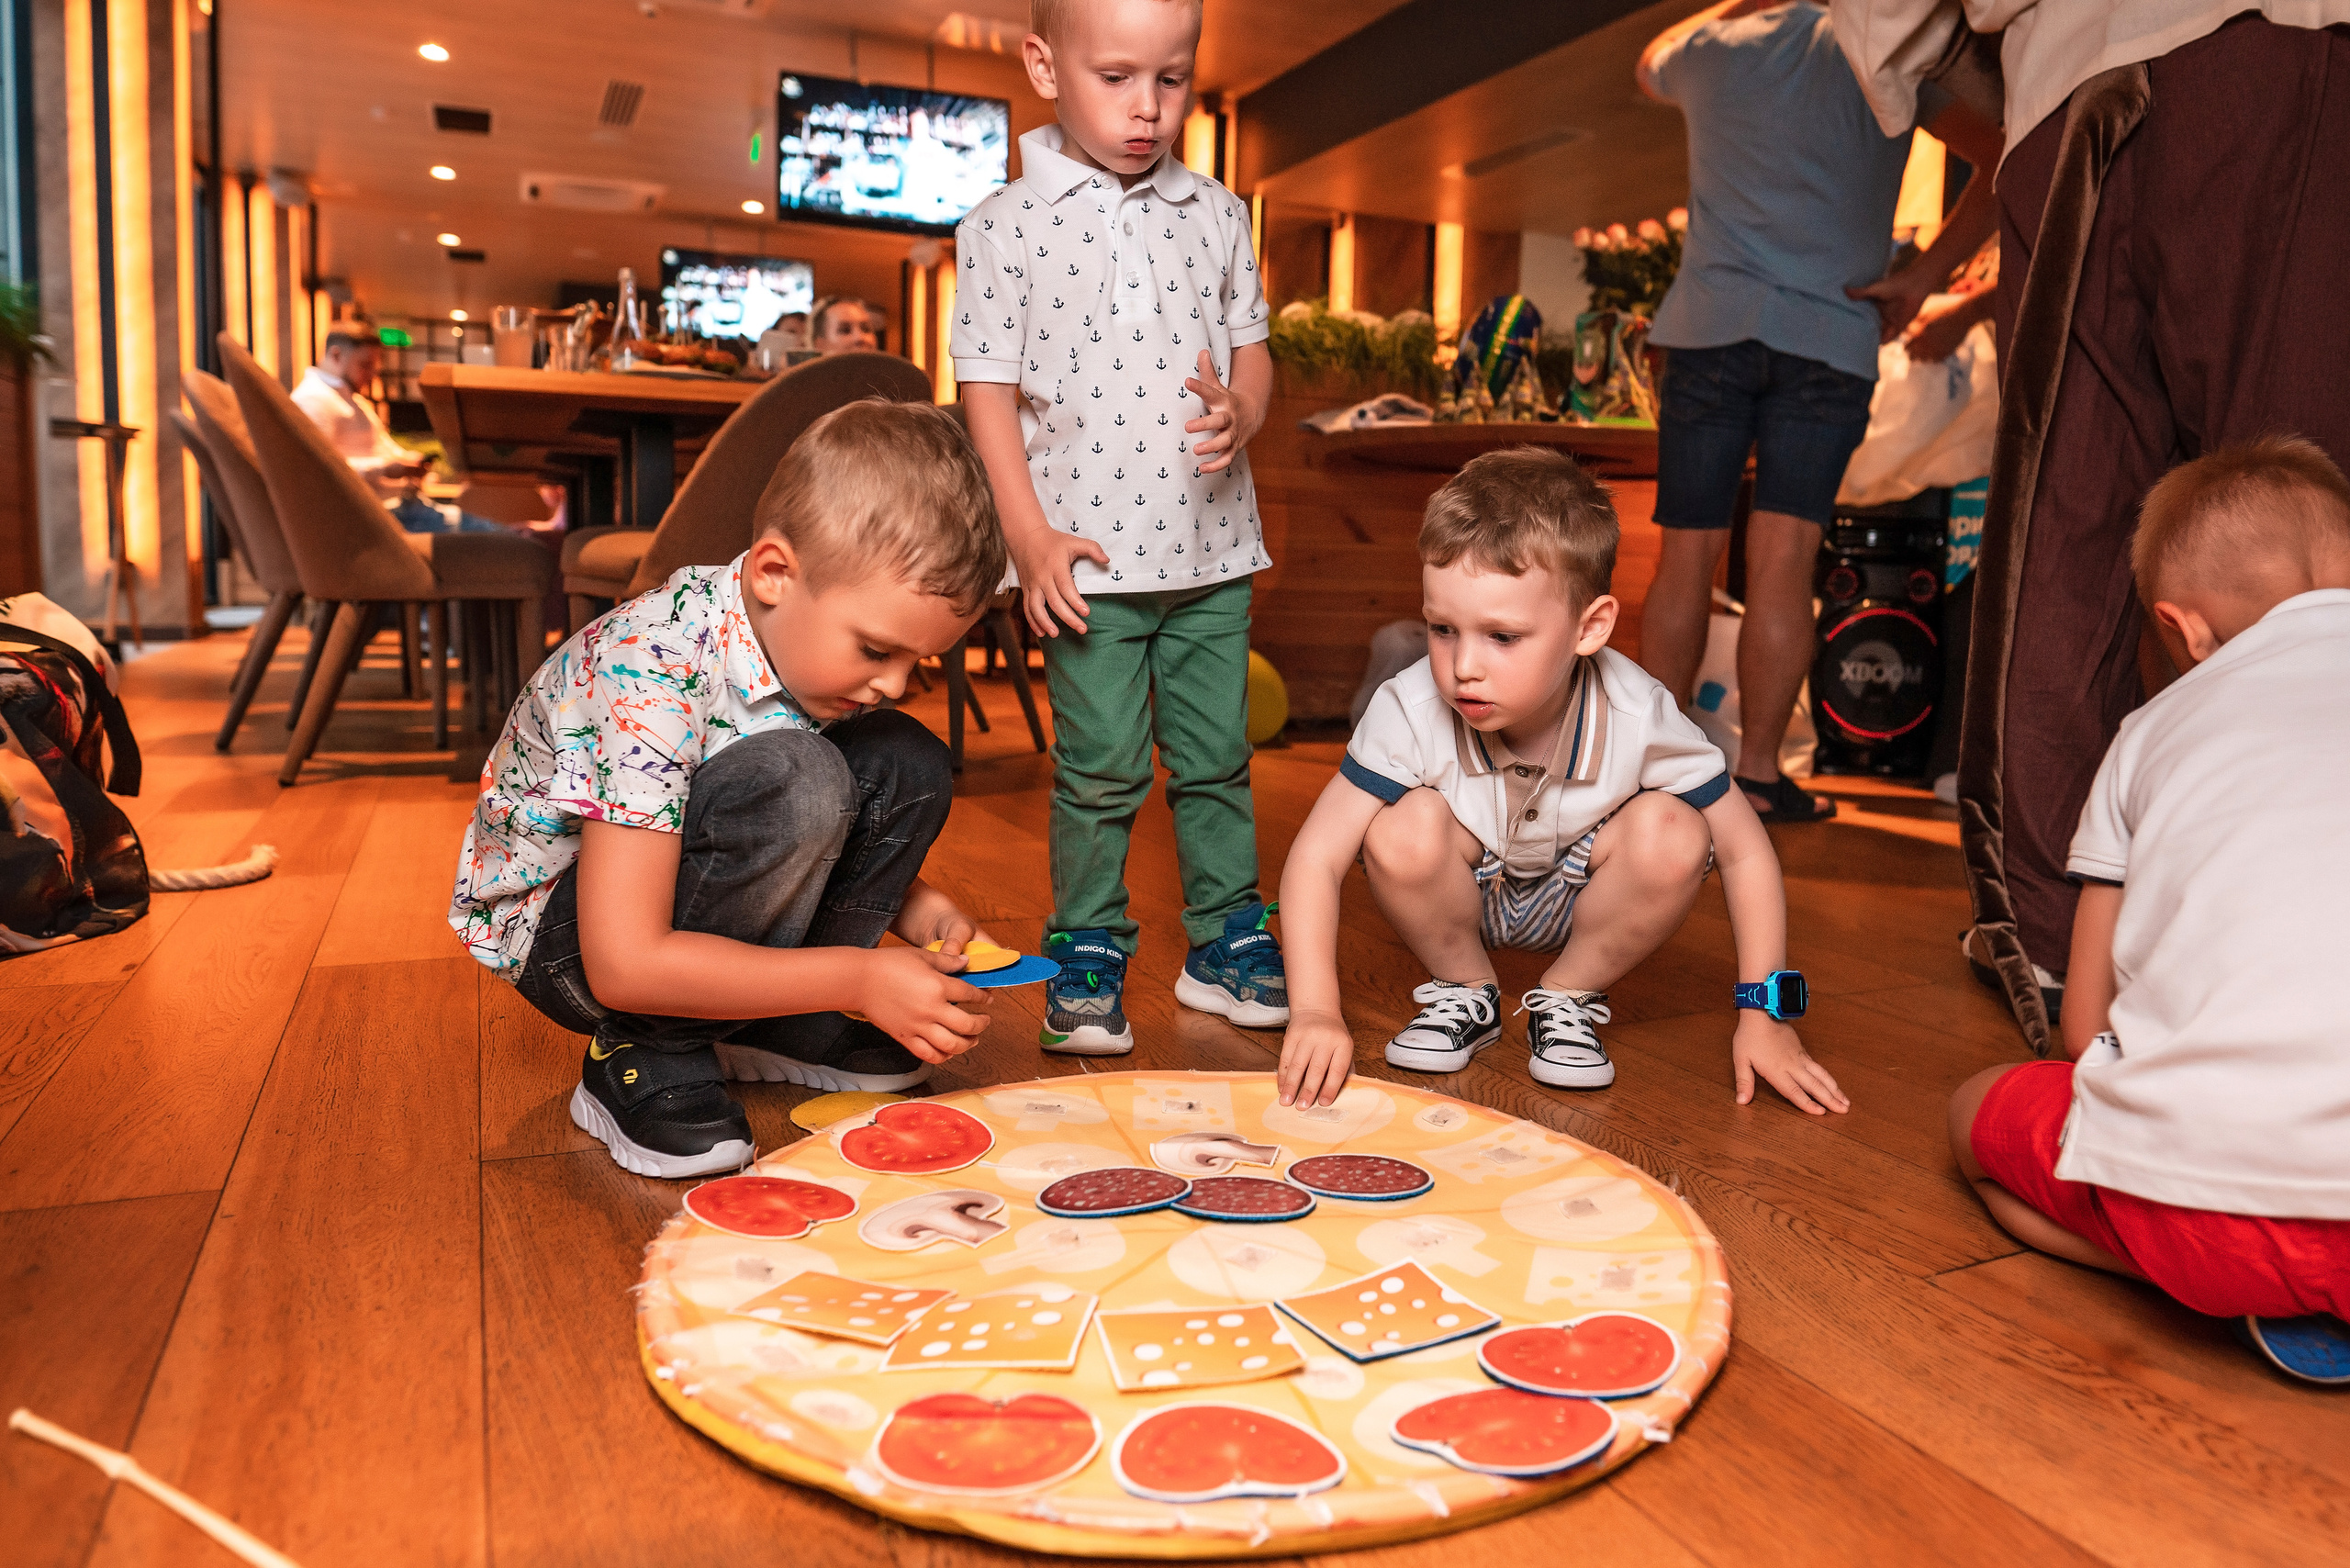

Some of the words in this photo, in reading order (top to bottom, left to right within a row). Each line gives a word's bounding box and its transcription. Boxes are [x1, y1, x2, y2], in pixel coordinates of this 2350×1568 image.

[1229, 935, 1258, 950] INDIGO
[1074, 945, 1105, 954] INDIGO
[1106, 948, 1123, 960] KIDS
